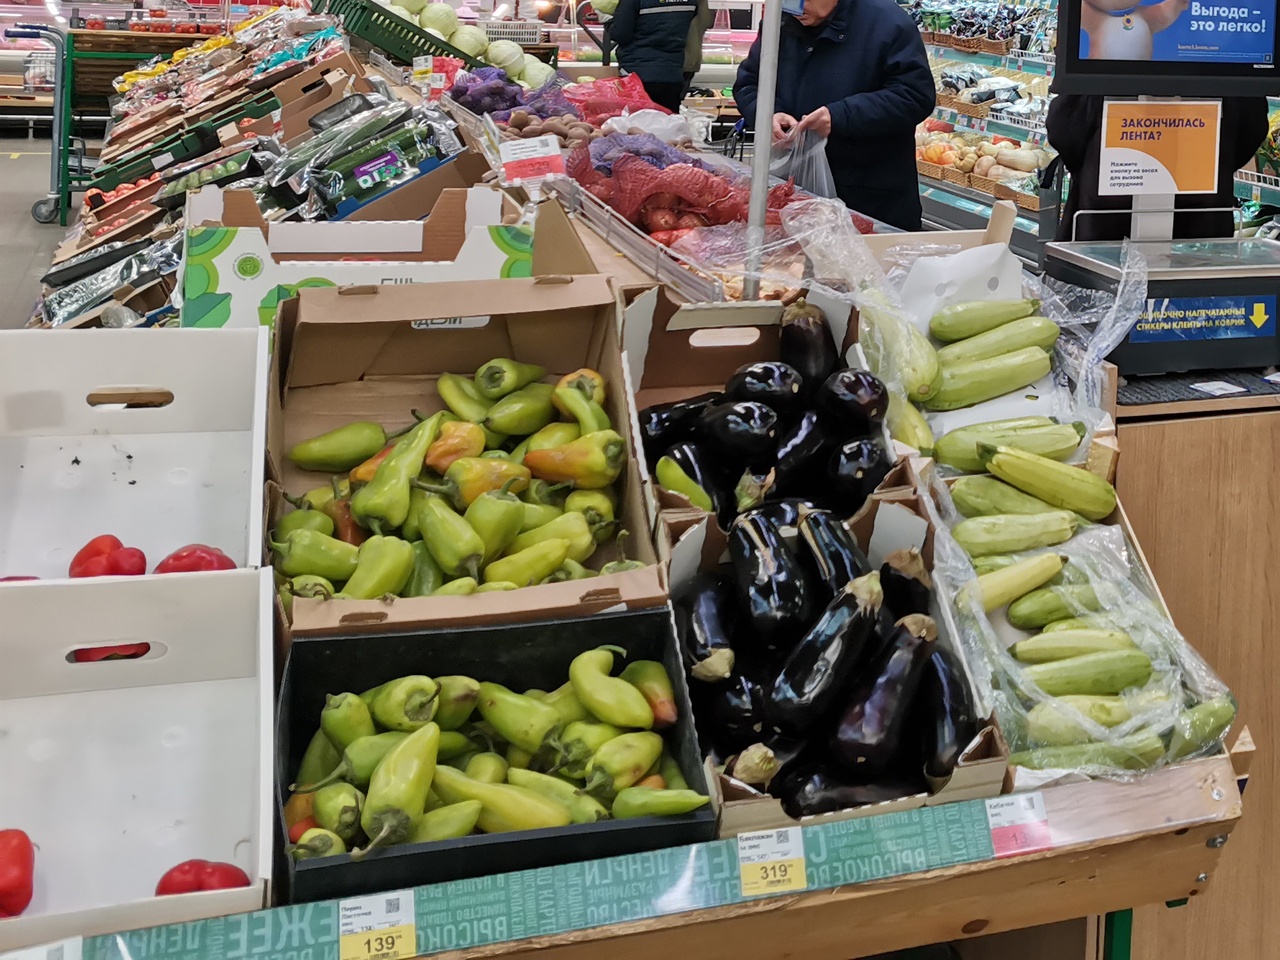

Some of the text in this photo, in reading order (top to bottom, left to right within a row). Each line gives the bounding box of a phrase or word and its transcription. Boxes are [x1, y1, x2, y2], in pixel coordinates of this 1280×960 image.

[1191, 1, 1249, 19] Выгода
[1190, 19, 1266, 33] это легко!
[1121, 118, 1206, 128] ЗАКОНЧИЛАСЬ
[1120, 131, 1162, 141] ЛЕНТА?
[1136, 321, 1172, 331] СТИКЕРЫ
[1202, 320, 1213, 328] НА
[1215, 318, 1246, 327] КОВРИК
[584, 852, 671, 888] ДЕНЬГИ
[760, 863, 788, 880] 319
[807, 848, 927, 889] ВЫСОКОЕ ВС
[226, 902, 338, 956] ЕЖЕЕ
[417, 916, 507, 952] ВЫСОКО
[364, 935, 396, 954] 139
